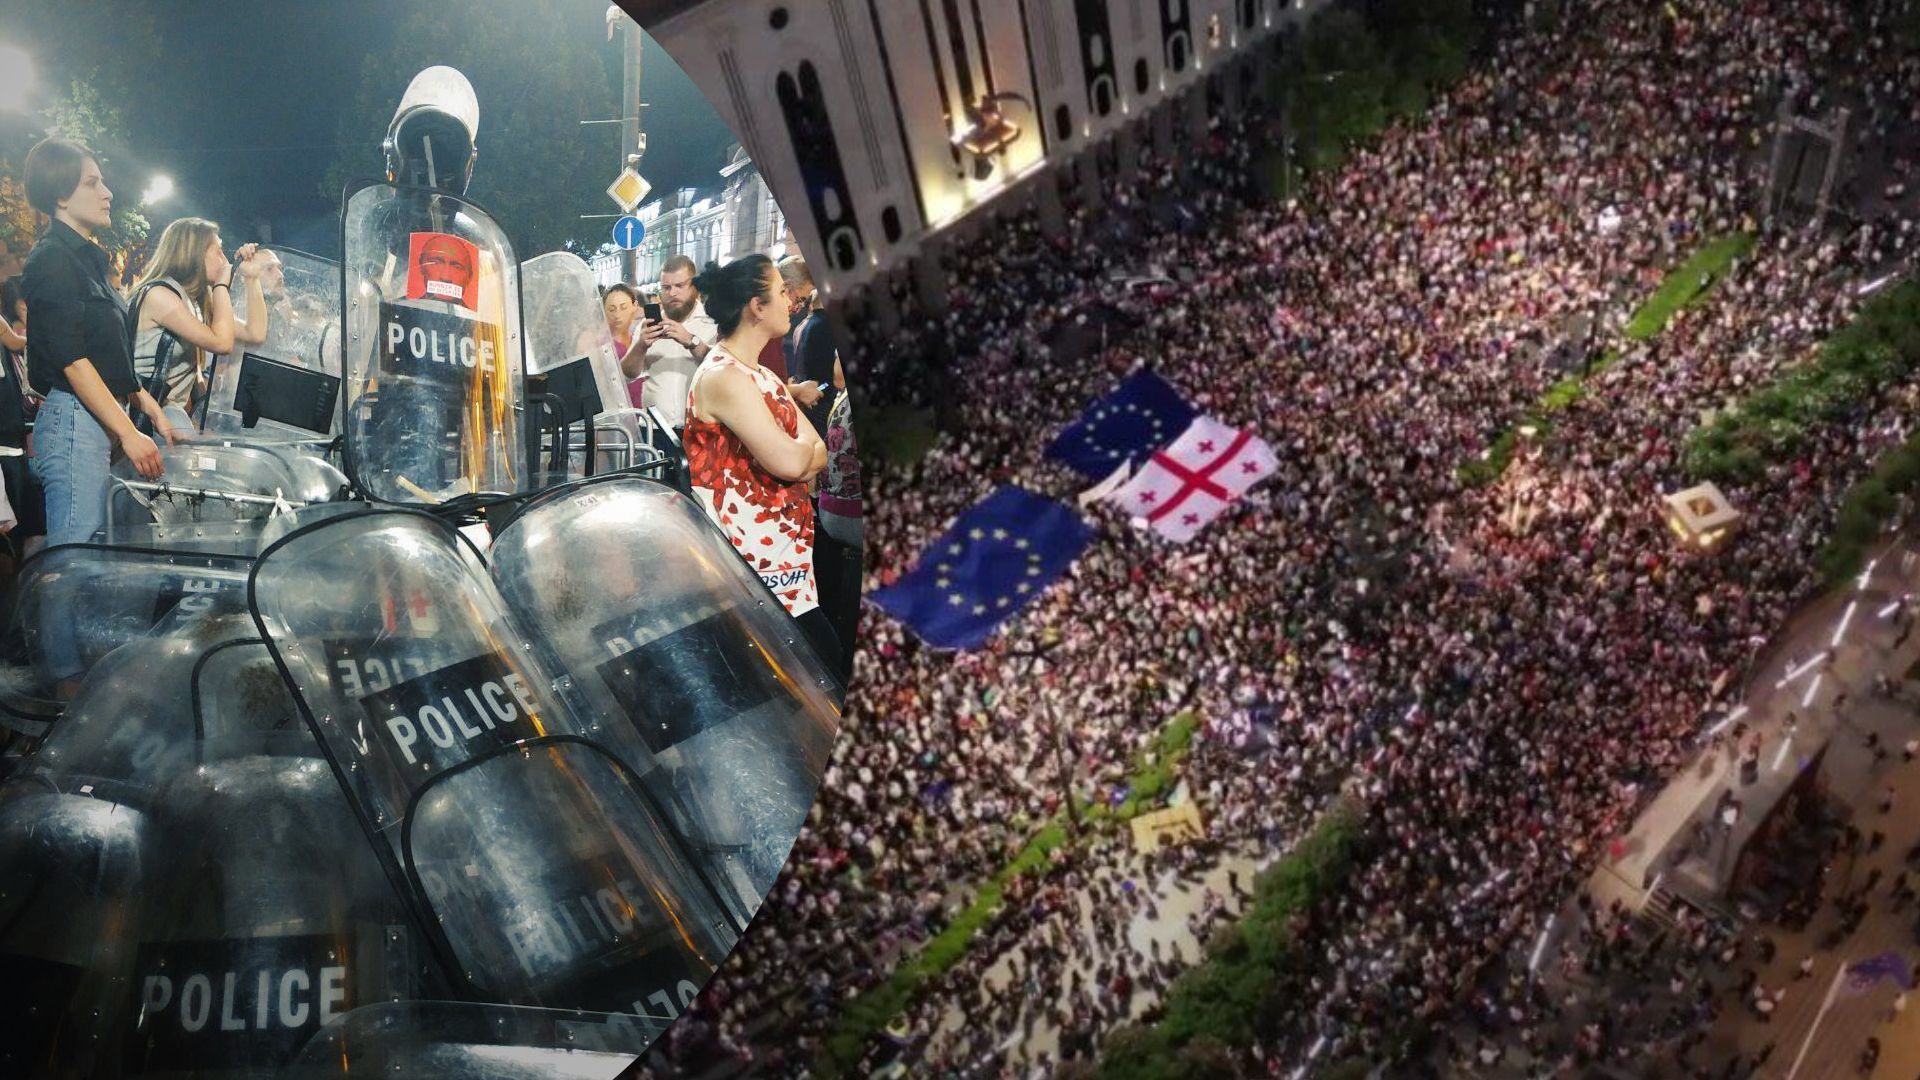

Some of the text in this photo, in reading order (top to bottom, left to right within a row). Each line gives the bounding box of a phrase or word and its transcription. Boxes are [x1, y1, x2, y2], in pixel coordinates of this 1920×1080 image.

[387, 322, 496, 373] POLICE
[386, 672, 542, 764] POLICE
[503, 880, 654, 978] POLICE
[143, 967, 347, 1032] POLICE
